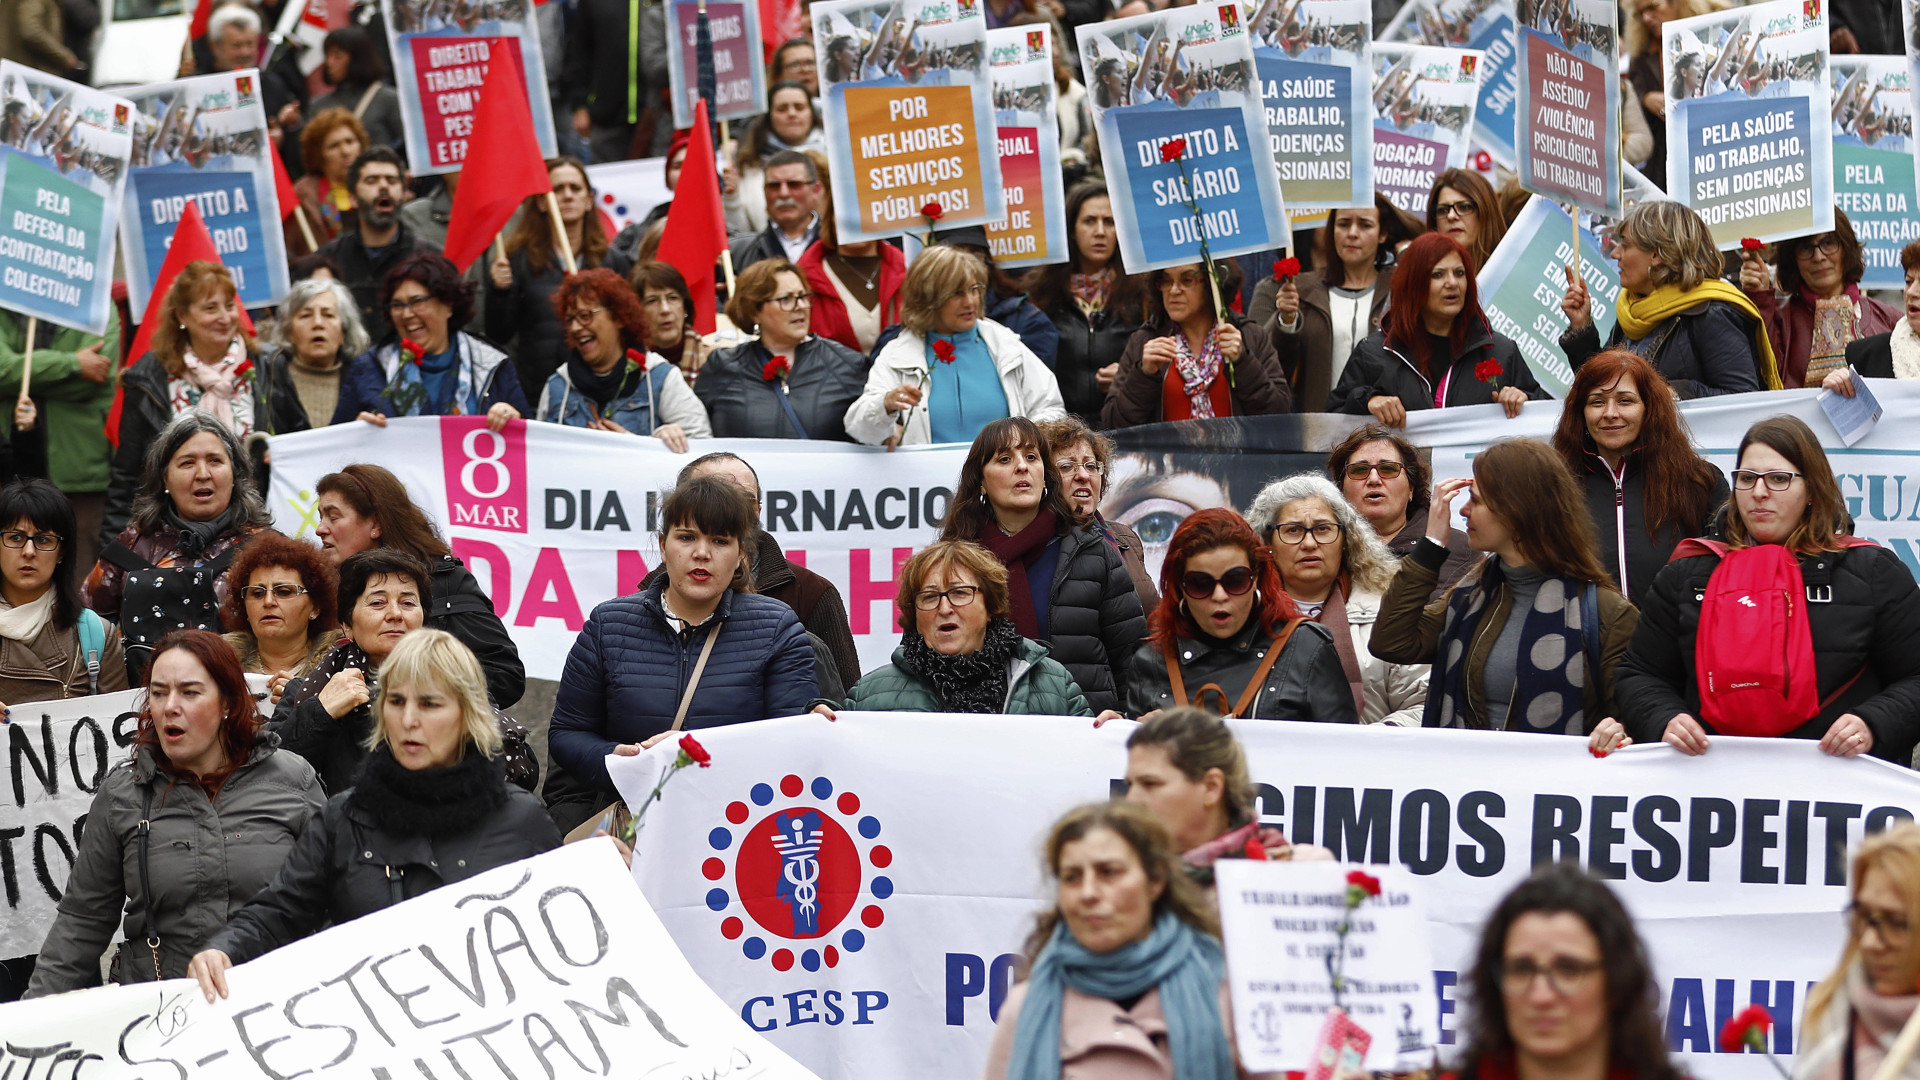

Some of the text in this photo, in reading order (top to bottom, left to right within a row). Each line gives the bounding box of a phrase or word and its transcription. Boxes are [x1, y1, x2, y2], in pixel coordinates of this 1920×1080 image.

[428, 40, 490, 69] DIREITO
[1546, 53, 1584, 82] NÃO AO
[436, 90, 474, 115] COM
[1282, 76, 1336, 99] SAÚDE
[1542, 78, 1591, 110] ASSÉDIO/
[889, 96, 928, 122] POR
[1266, 106, 1345, 127] RABALHO,
[1537, 105, 1595, 141] /VIOLÊNCIA
[860, 123, 965, 159] MELHORES
[1224, 125, 1239, 152] A
[1270, 134, 1345, 156] DOENÇAS
[1702, 111, 1794, 147] PELA SAÚDE
[997, 136, 1034, 157] GUAL
[1534, 131, 1599, 170] PSICOLÓGICA
[1694, 137, 1804, 174] NO TRABALHO,
[869, 156, 964, 191] SERVIÇOS
[1152, 167, 1240, 207] SALÁRIO
[1374, 165, 1436, 190] NORMAS
[1533, 157, 1602, 196] NO TRABALHO
[1696, 163, 1804, 200] SEM DOENÇAS
[1845, 165, 1885, 184] PELA
[36, 188, 70, 216] PELA
[233, 186, 249, 213] A
[1834, 192, 1907, 212] EFESA DA
[13, 210, 86, 250] DEFESA DA
[1011, 210, 1032, 230] DE
[1169, 208, 1241, 245] DIGNO!
[1852, 217, 1920, 243] RATAÇÃO
[0, 235, 94, 281] CONTRATAÇÃO
[988, 235, 1037, 257] VALOR
[4, 266, 82, 307] COLECTIVA!
[1555, 241, 1620, 303] DIEITO A
[1486, 303, 1576, 387] PRECARIEDAD
[460, 428, 511, 499] 8
[454, 503, 521, 529] MAR
[544, 488, 631, 532] DIA
[741, 990, 889, 1032] CESP
